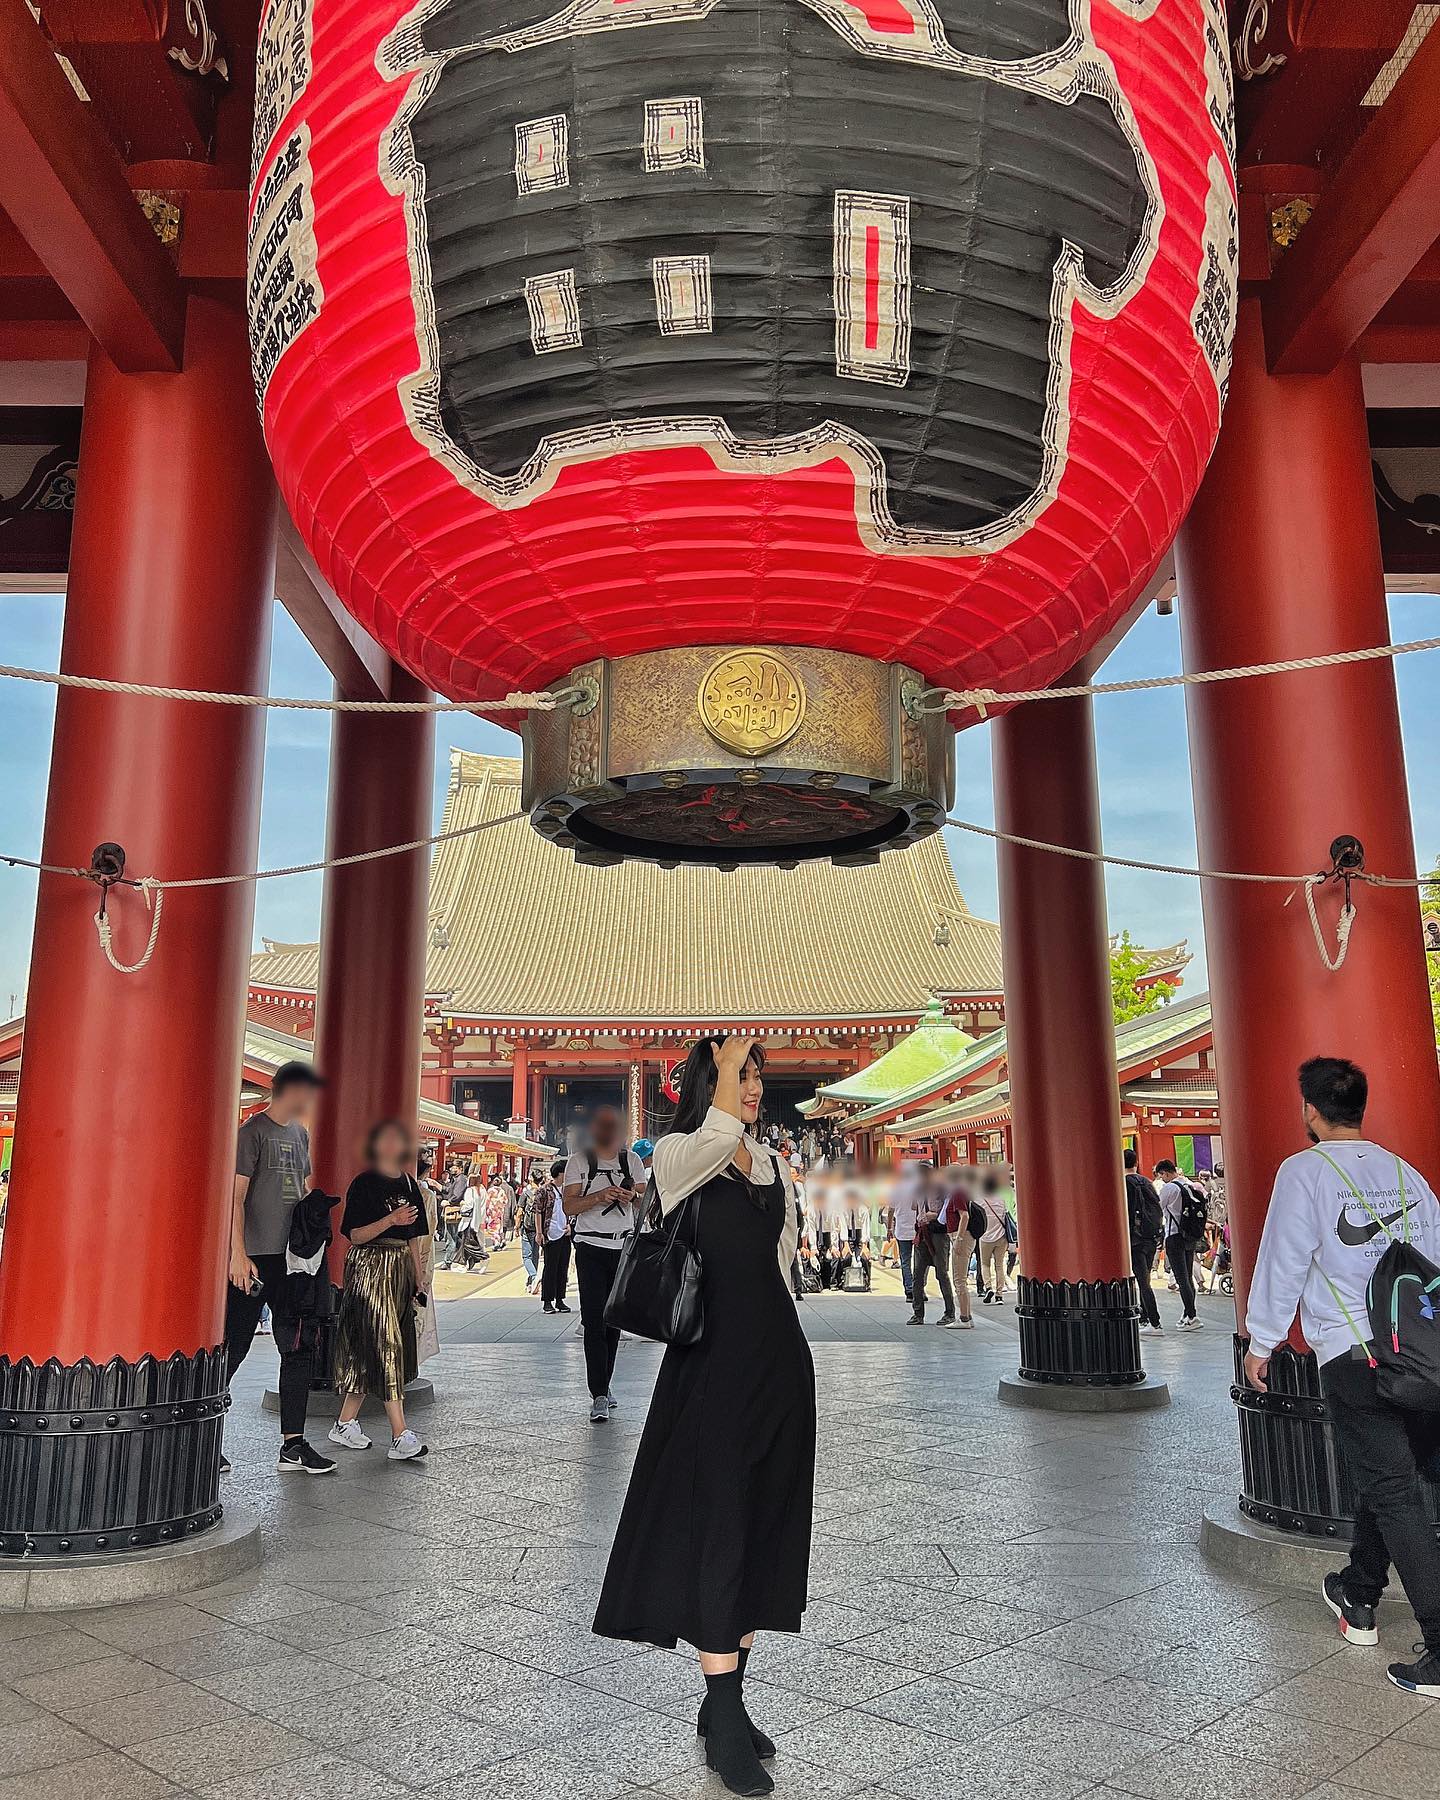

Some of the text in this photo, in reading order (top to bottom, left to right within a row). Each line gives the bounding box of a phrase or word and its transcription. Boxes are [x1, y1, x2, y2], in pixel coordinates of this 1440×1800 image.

[1365, 1187, 1413, 1198] Internatioal
[1343, 1201, 1377, 1210] Godss
[1378, 1201, 1388, 1209] of
[1395, 1222, 1419, 1232] 9705
